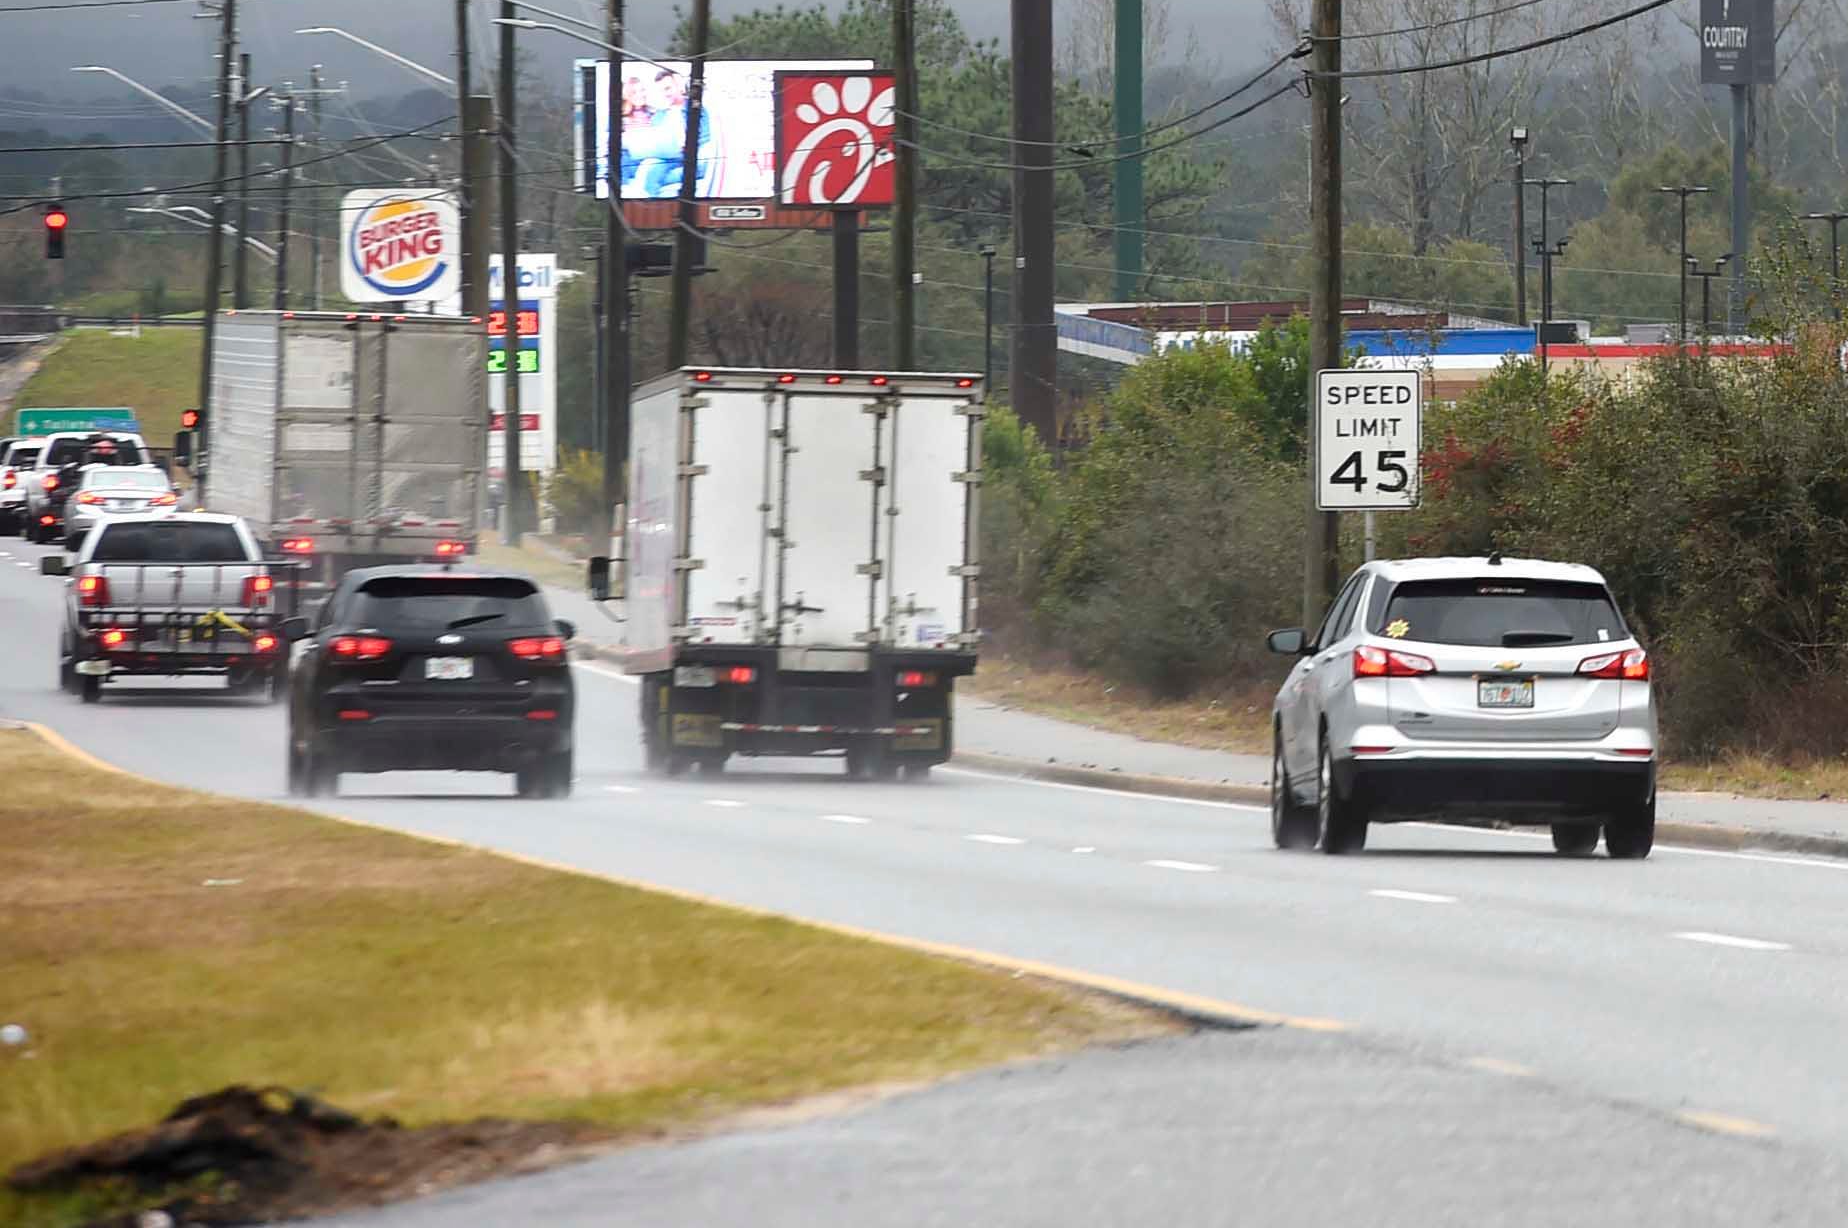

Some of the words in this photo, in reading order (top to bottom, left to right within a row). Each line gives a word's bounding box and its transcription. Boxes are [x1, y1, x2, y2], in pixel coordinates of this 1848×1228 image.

[1703, 25, 1748, 48] COUNTRY
[359, 211, 440, 249] BURGER
[363, 229, 443, 276] KING
[1327, 385, 1412, 405] SPEED
[1336, 418, 1402, 437] LIMIT
[1329, 450, 1409, 493] 45
